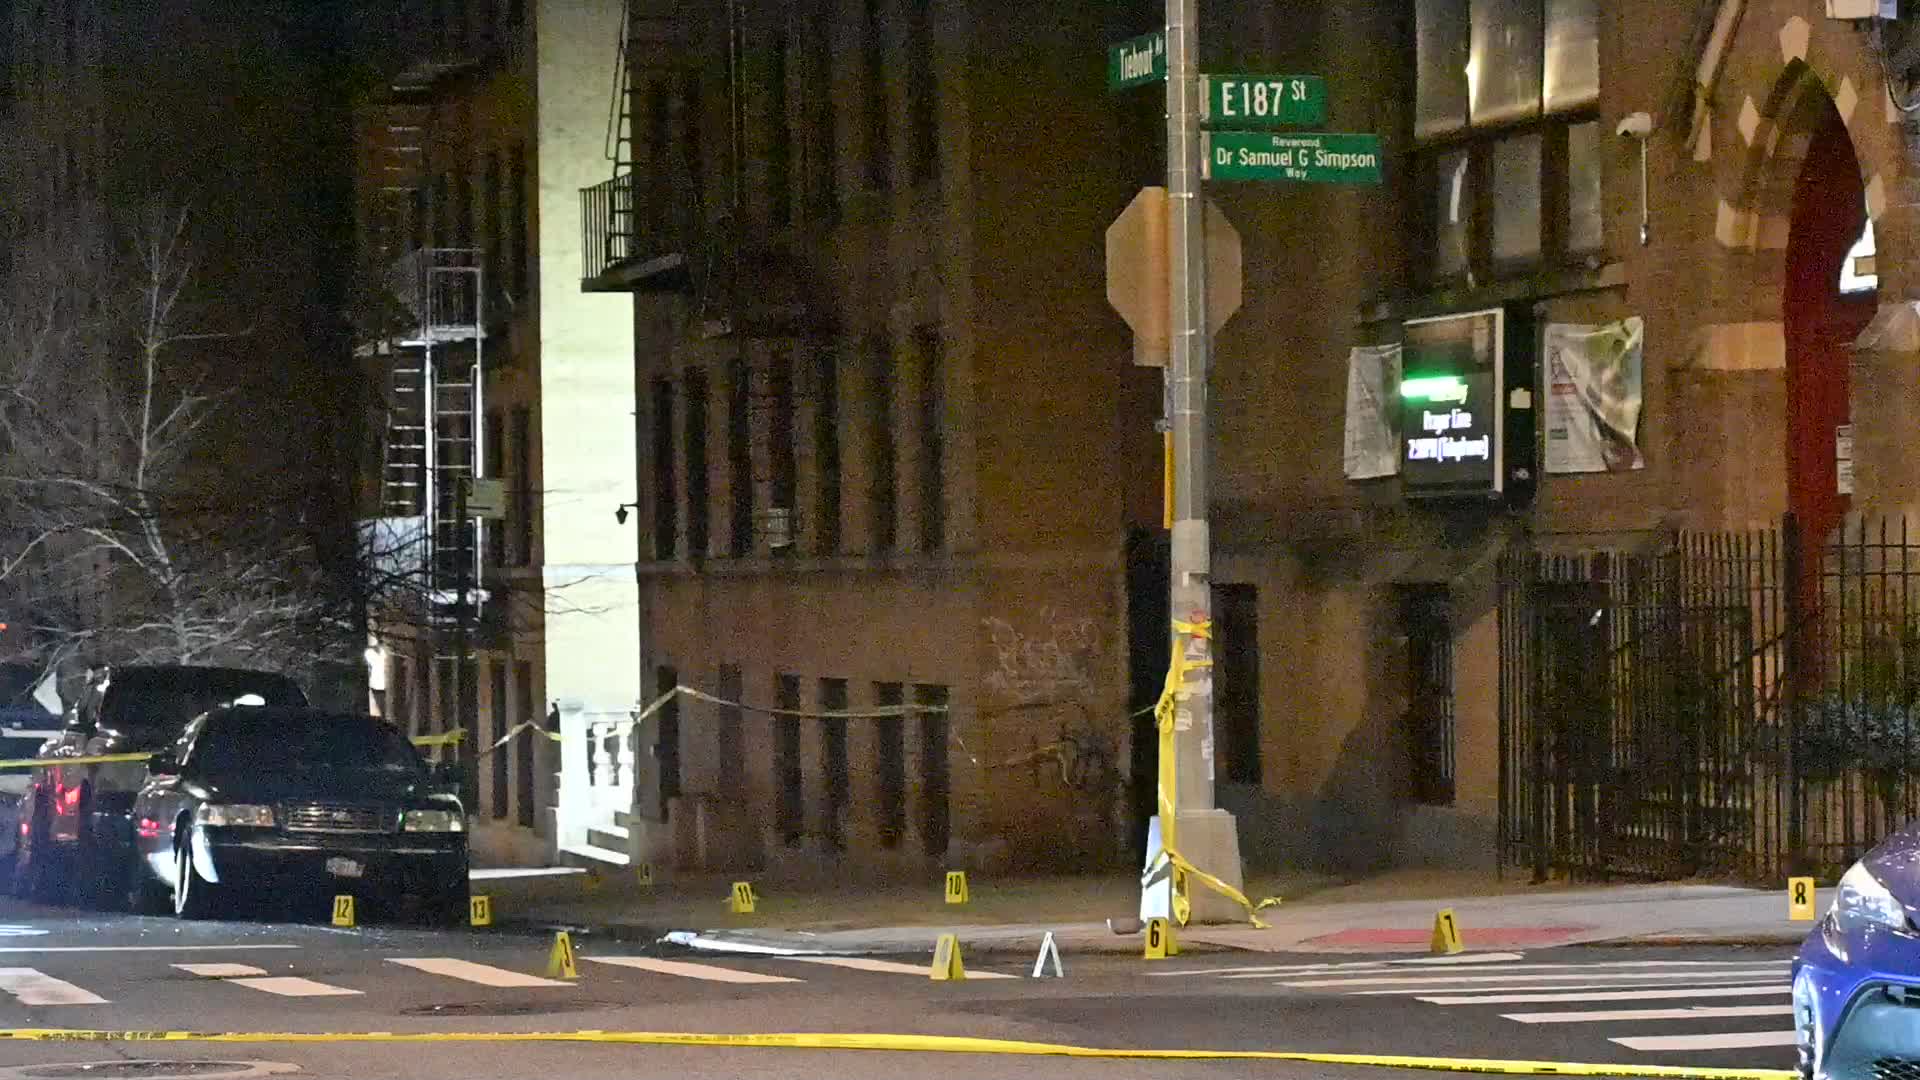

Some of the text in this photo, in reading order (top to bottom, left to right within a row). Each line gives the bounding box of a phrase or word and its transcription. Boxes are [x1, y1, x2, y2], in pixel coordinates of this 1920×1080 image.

[1120, 40, 1153, 81] Tiebout
[1222, 80, 1306, 116] E 187 St
[1272, 136, 1320, 147] Reverend
[1216, 147, 1376, 171] Dr Samuel G Simpson
[1285, 167, 1307, 180] Way
[738, 885, 751, 905] 11
[949, 875, 961, 895] 10
[1795, 881, 1806, 905] 8
[336, 898, 350, 918] 12
[473, 900, 485, 919] 13
[1150, 919, 1160, 948] 6
[1444, 914, 1456, 943] 7
